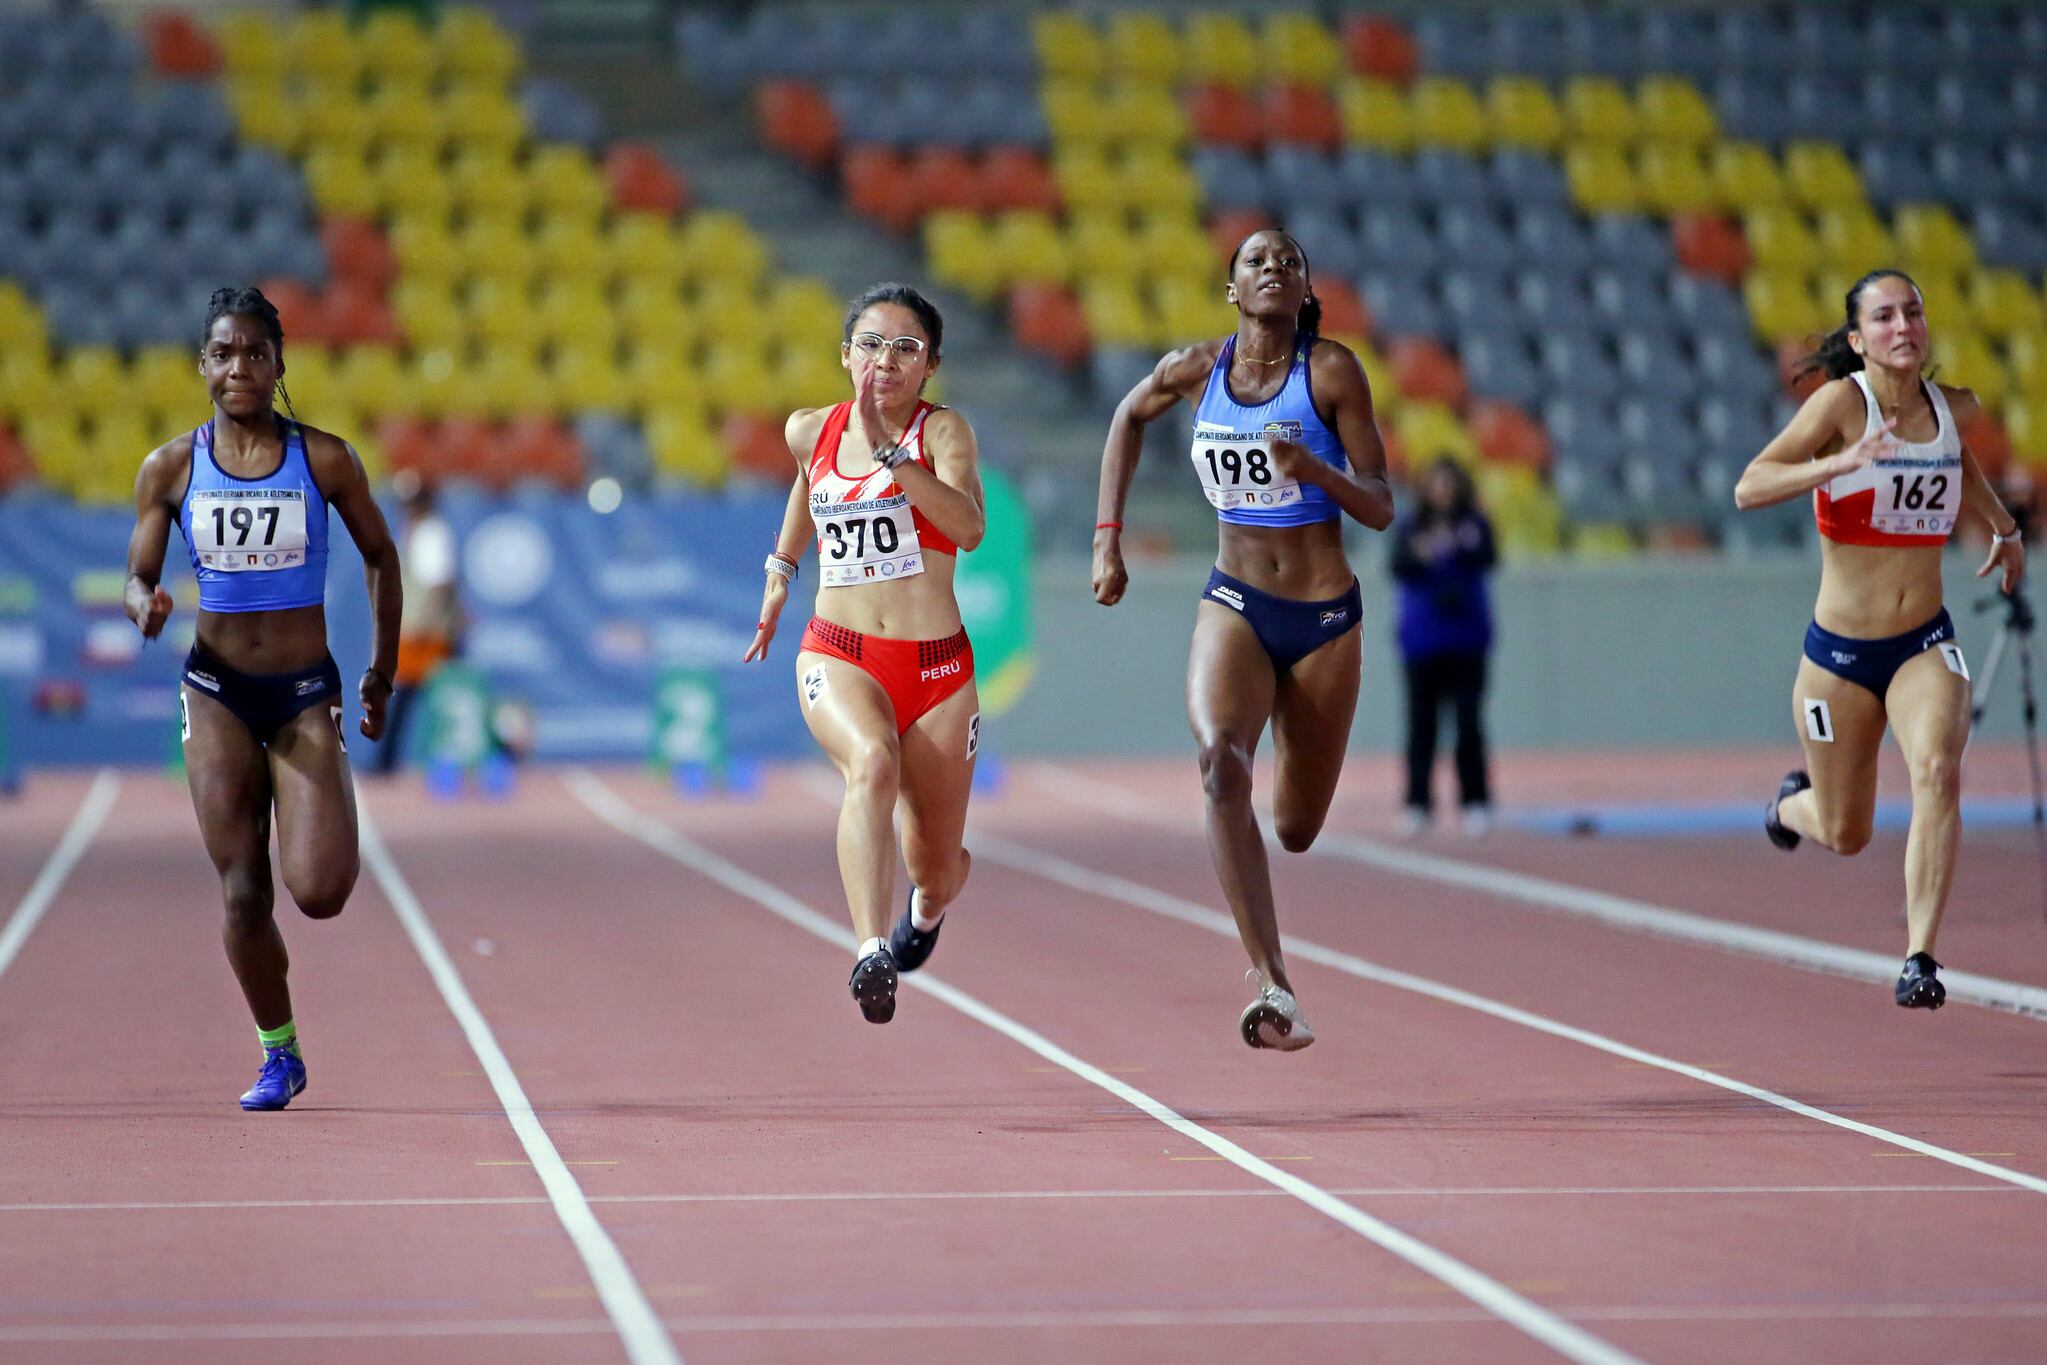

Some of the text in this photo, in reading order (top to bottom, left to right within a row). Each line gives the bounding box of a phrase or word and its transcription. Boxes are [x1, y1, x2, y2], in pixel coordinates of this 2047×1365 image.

[1248, 432, 1255, 440] DE
[1205, 449, 1272, 485] 198
[263, 490, 270, 498] DE
[270, 490, 294, 498] ATLETISMO
[832, 501, 869, 514] IBEROAMERICANO
[868, 501, 875, 510] DE
[875, 498, 898, 509] ATLETISMO
[1892, 474, 1948, 511] 162
[212, 507, 280, 546] 197
[826, 516, 899, 560] 370
[921, 659, 960, 682] PERÚ
[1948, 648, 1963, 674] 1
[969, 715, 980, 753] 3
[1810, 705, 1826, 737] 1
